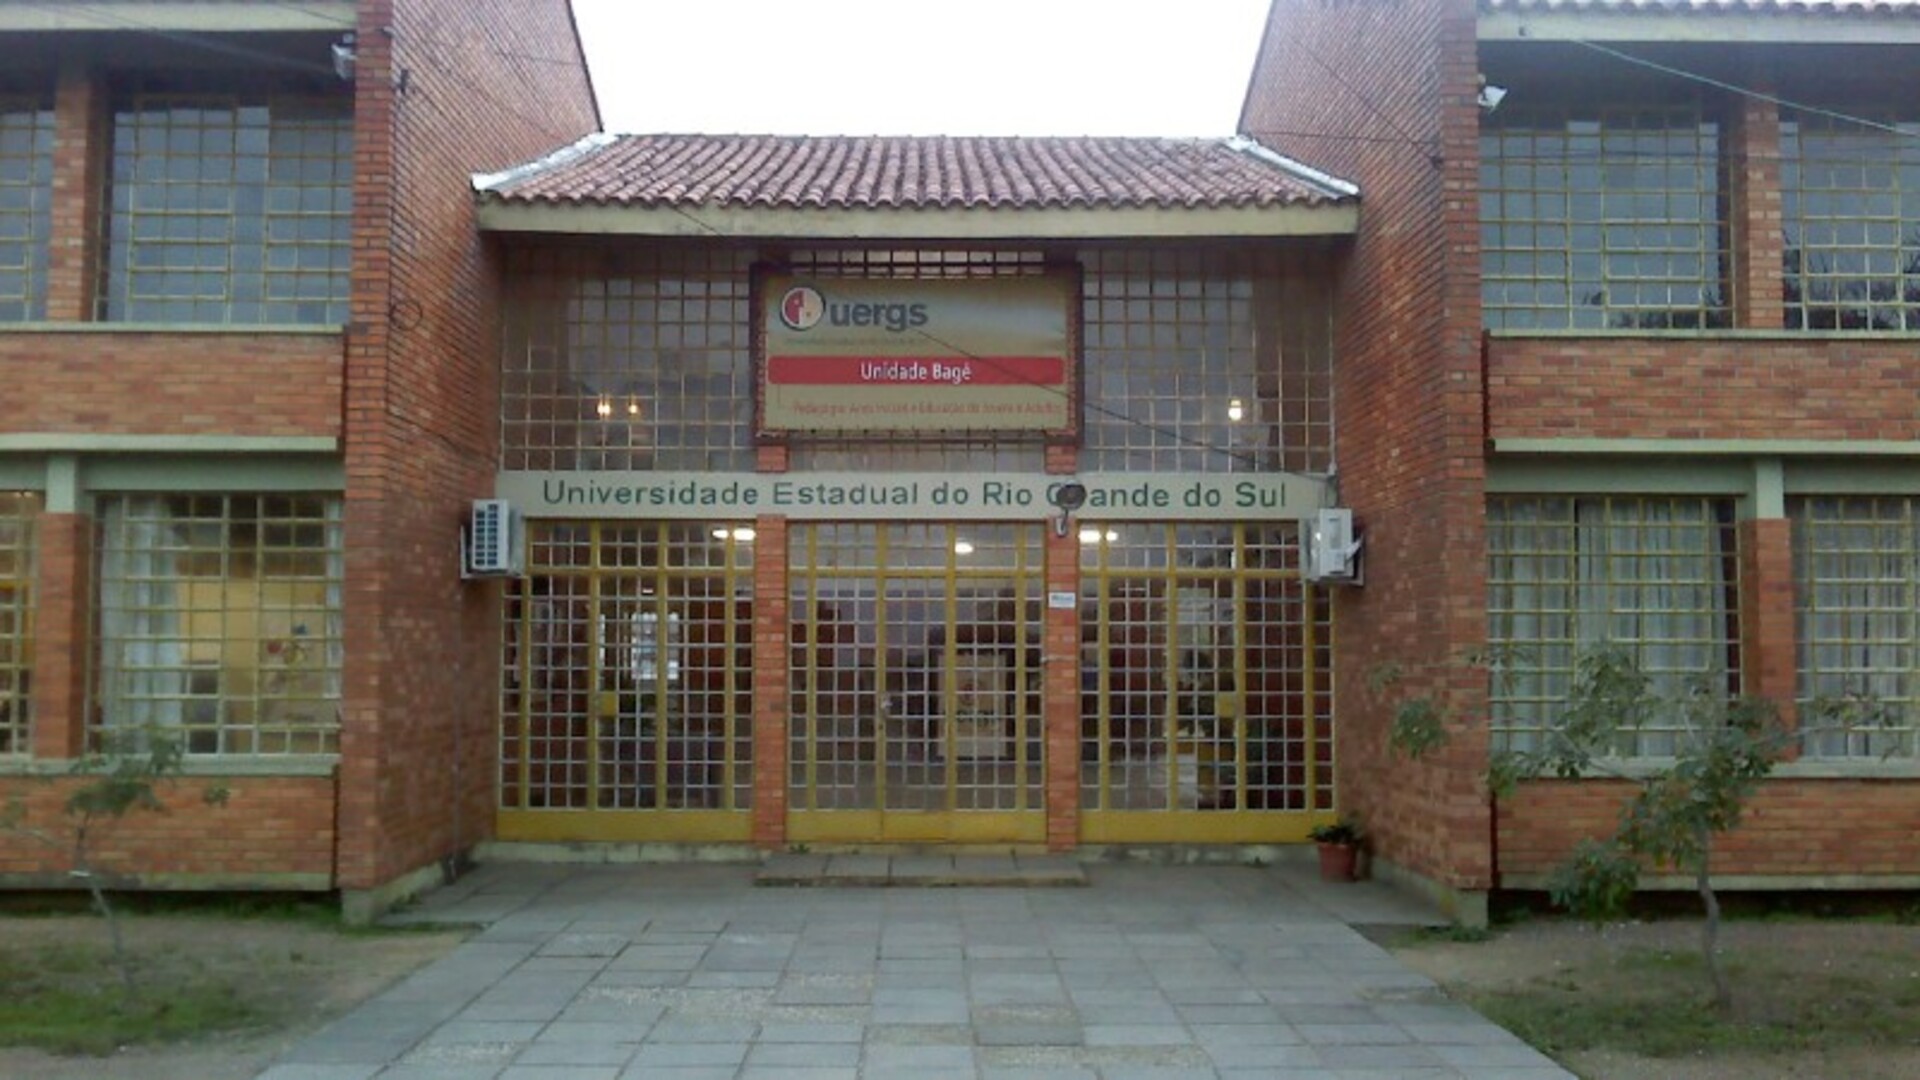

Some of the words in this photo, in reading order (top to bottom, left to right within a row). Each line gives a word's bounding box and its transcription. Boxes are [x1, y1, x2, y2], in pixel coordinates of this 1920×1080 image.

[830, 302, 928, 332] uergs
[860, 362, 928, 380] Unidade
[933, 361, 971, 384] Bagé
[543, 480, 759, 505] Universidade
[772, 481, 919, 506] Estadual
[931, 481, 969, 506] do
[982, 481, 1033, 507] Rio
[1046, 482, 1170, 508] Gande
[1184, 482, 1221, 507] do
[1235, 482, 1286, 508] Sul
